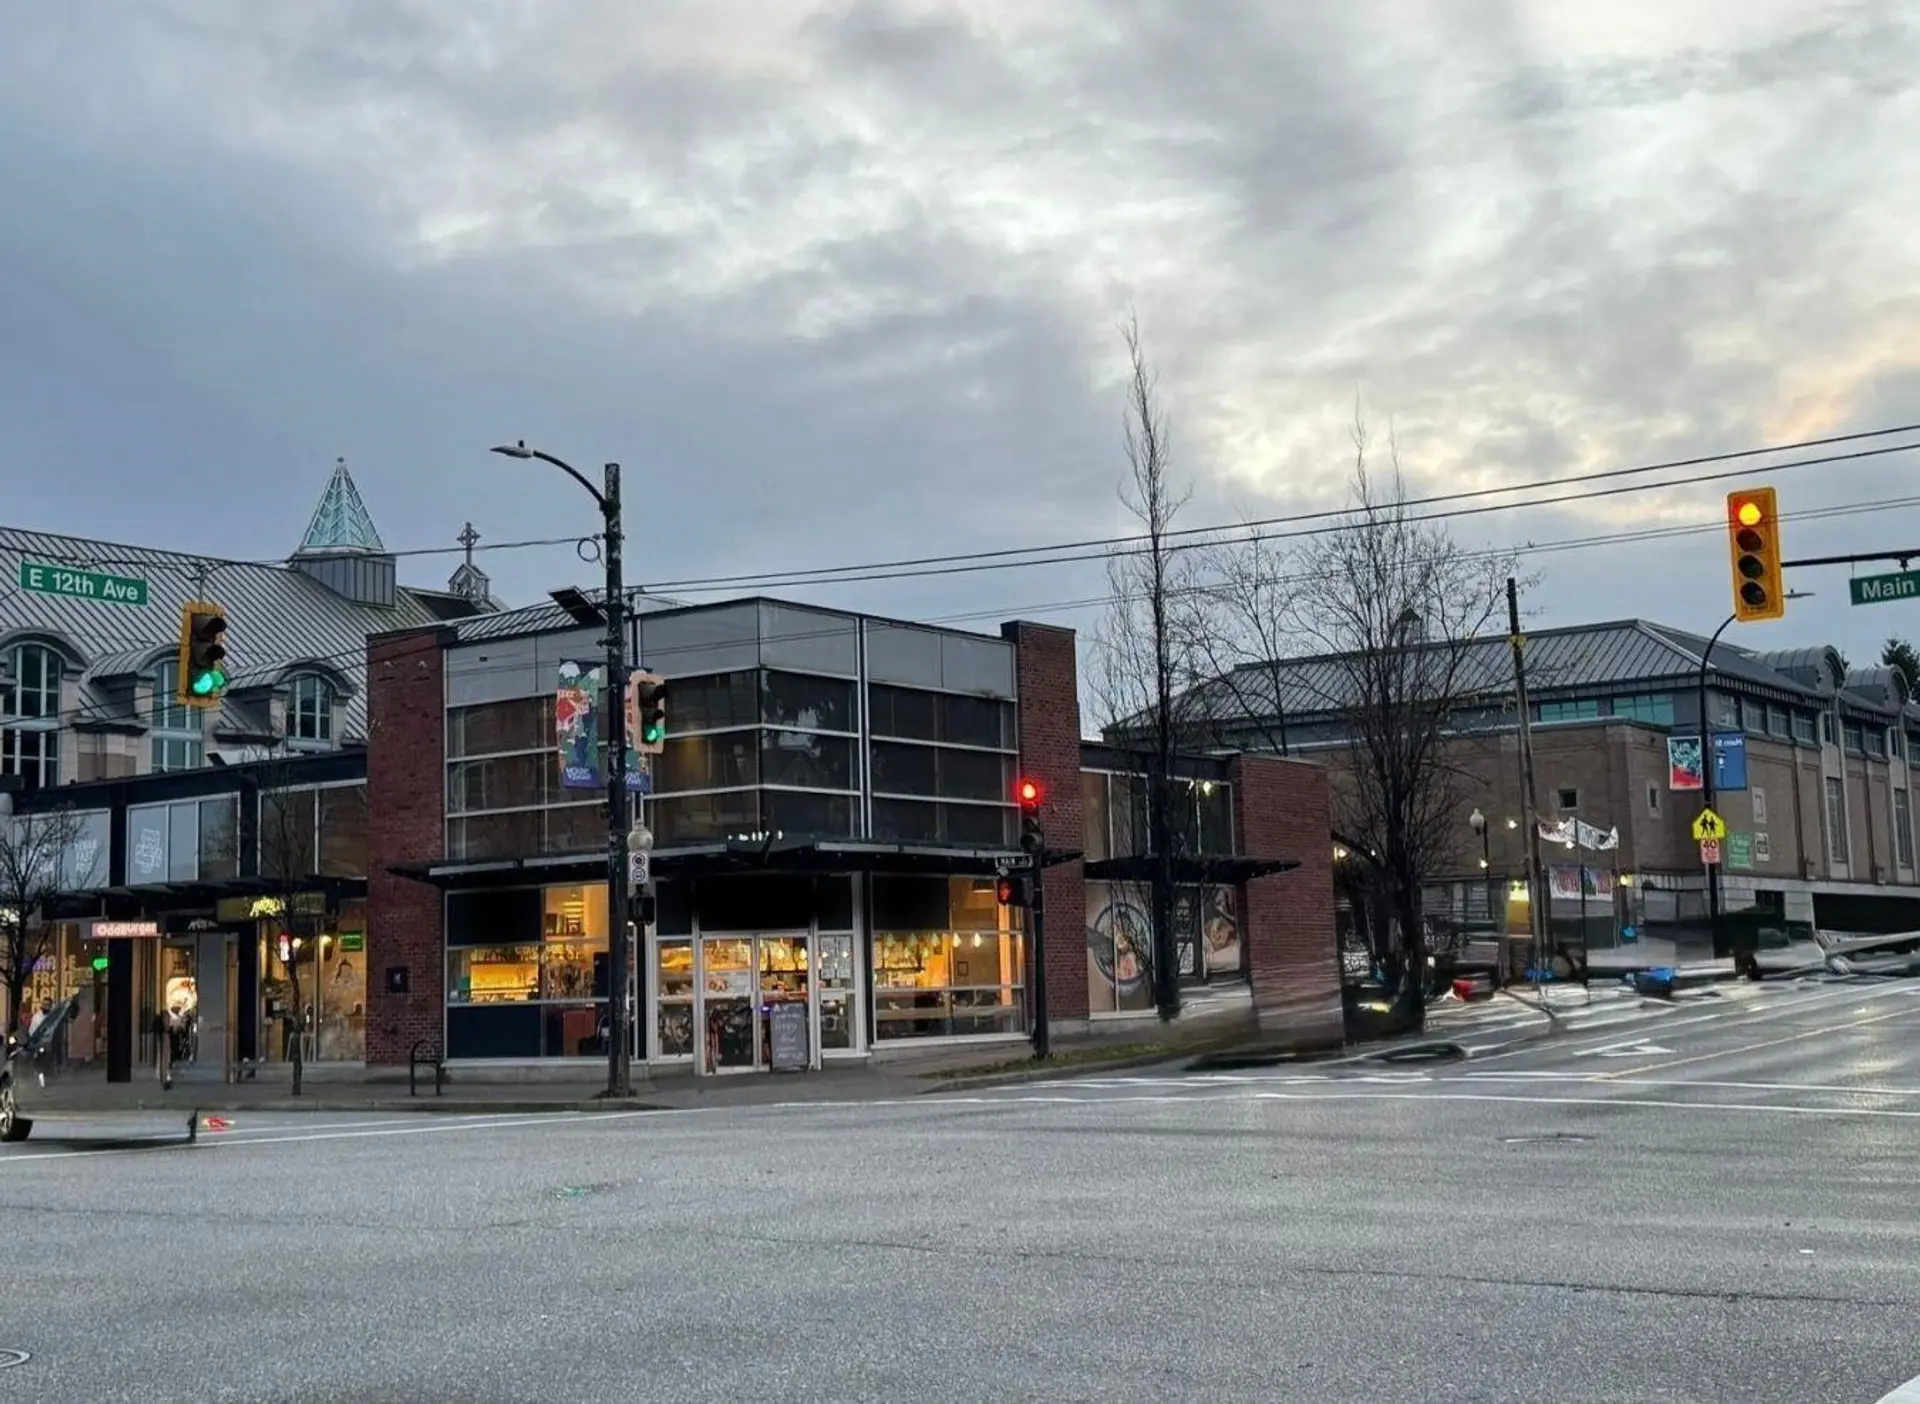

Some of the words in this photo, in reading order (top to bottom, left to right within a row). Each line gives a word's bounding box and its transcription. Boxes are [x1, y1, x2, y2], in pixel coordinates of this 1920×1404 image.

[29, 567, 43, 588] E
[52, 571, 95, 595] 12th
[103, 579, 138, 600] Ave
[1861, 577, 1915, 600] Main
[1702, 840, 1717, 849] 40
